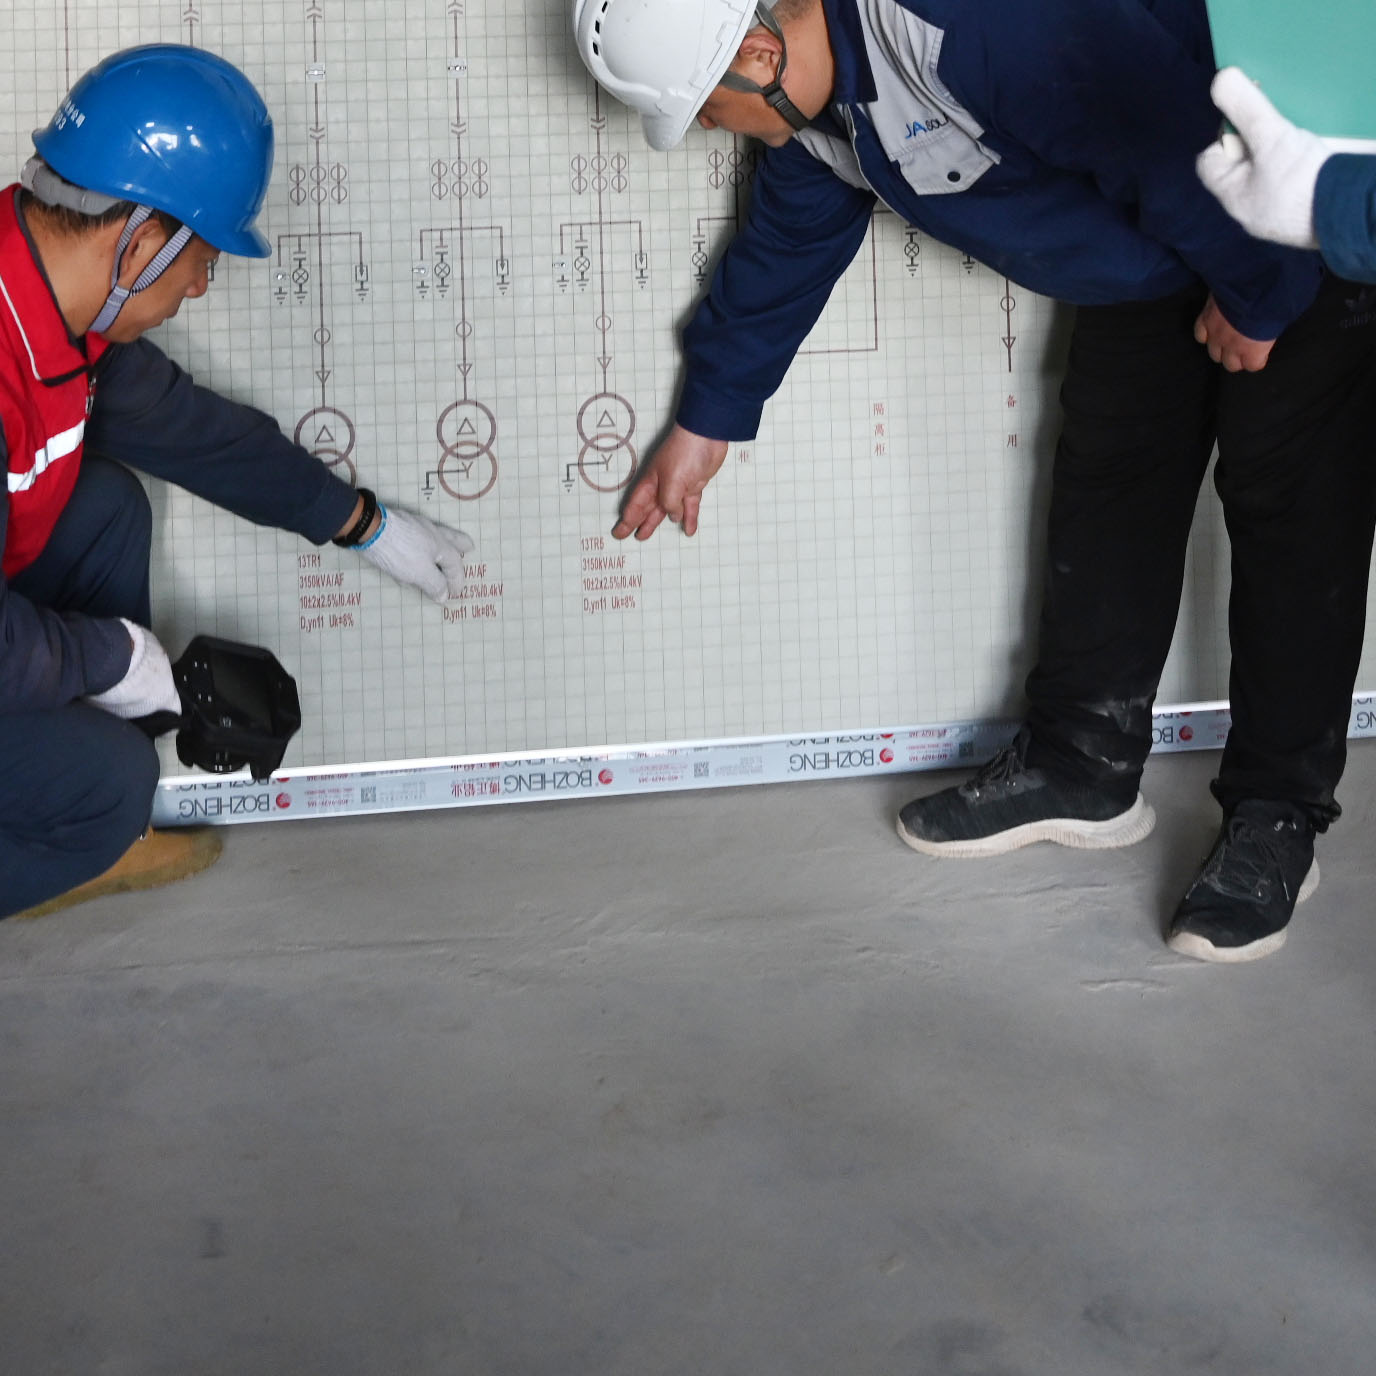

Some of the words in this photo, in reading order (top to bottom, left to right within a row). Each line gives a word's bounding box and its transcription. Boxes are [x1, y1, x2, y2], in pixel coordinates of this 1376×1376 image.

[298, 554, 320, 568] 13TR1
[463, 564, 487, 579] VA/AF
[790, 750, 874, 771] BOZHENG
[451, 780, 500, 799] 博正铝业
[504, 769, 591, 792] BOZHENG
[179, 793, 270, 818] BOZHENG
